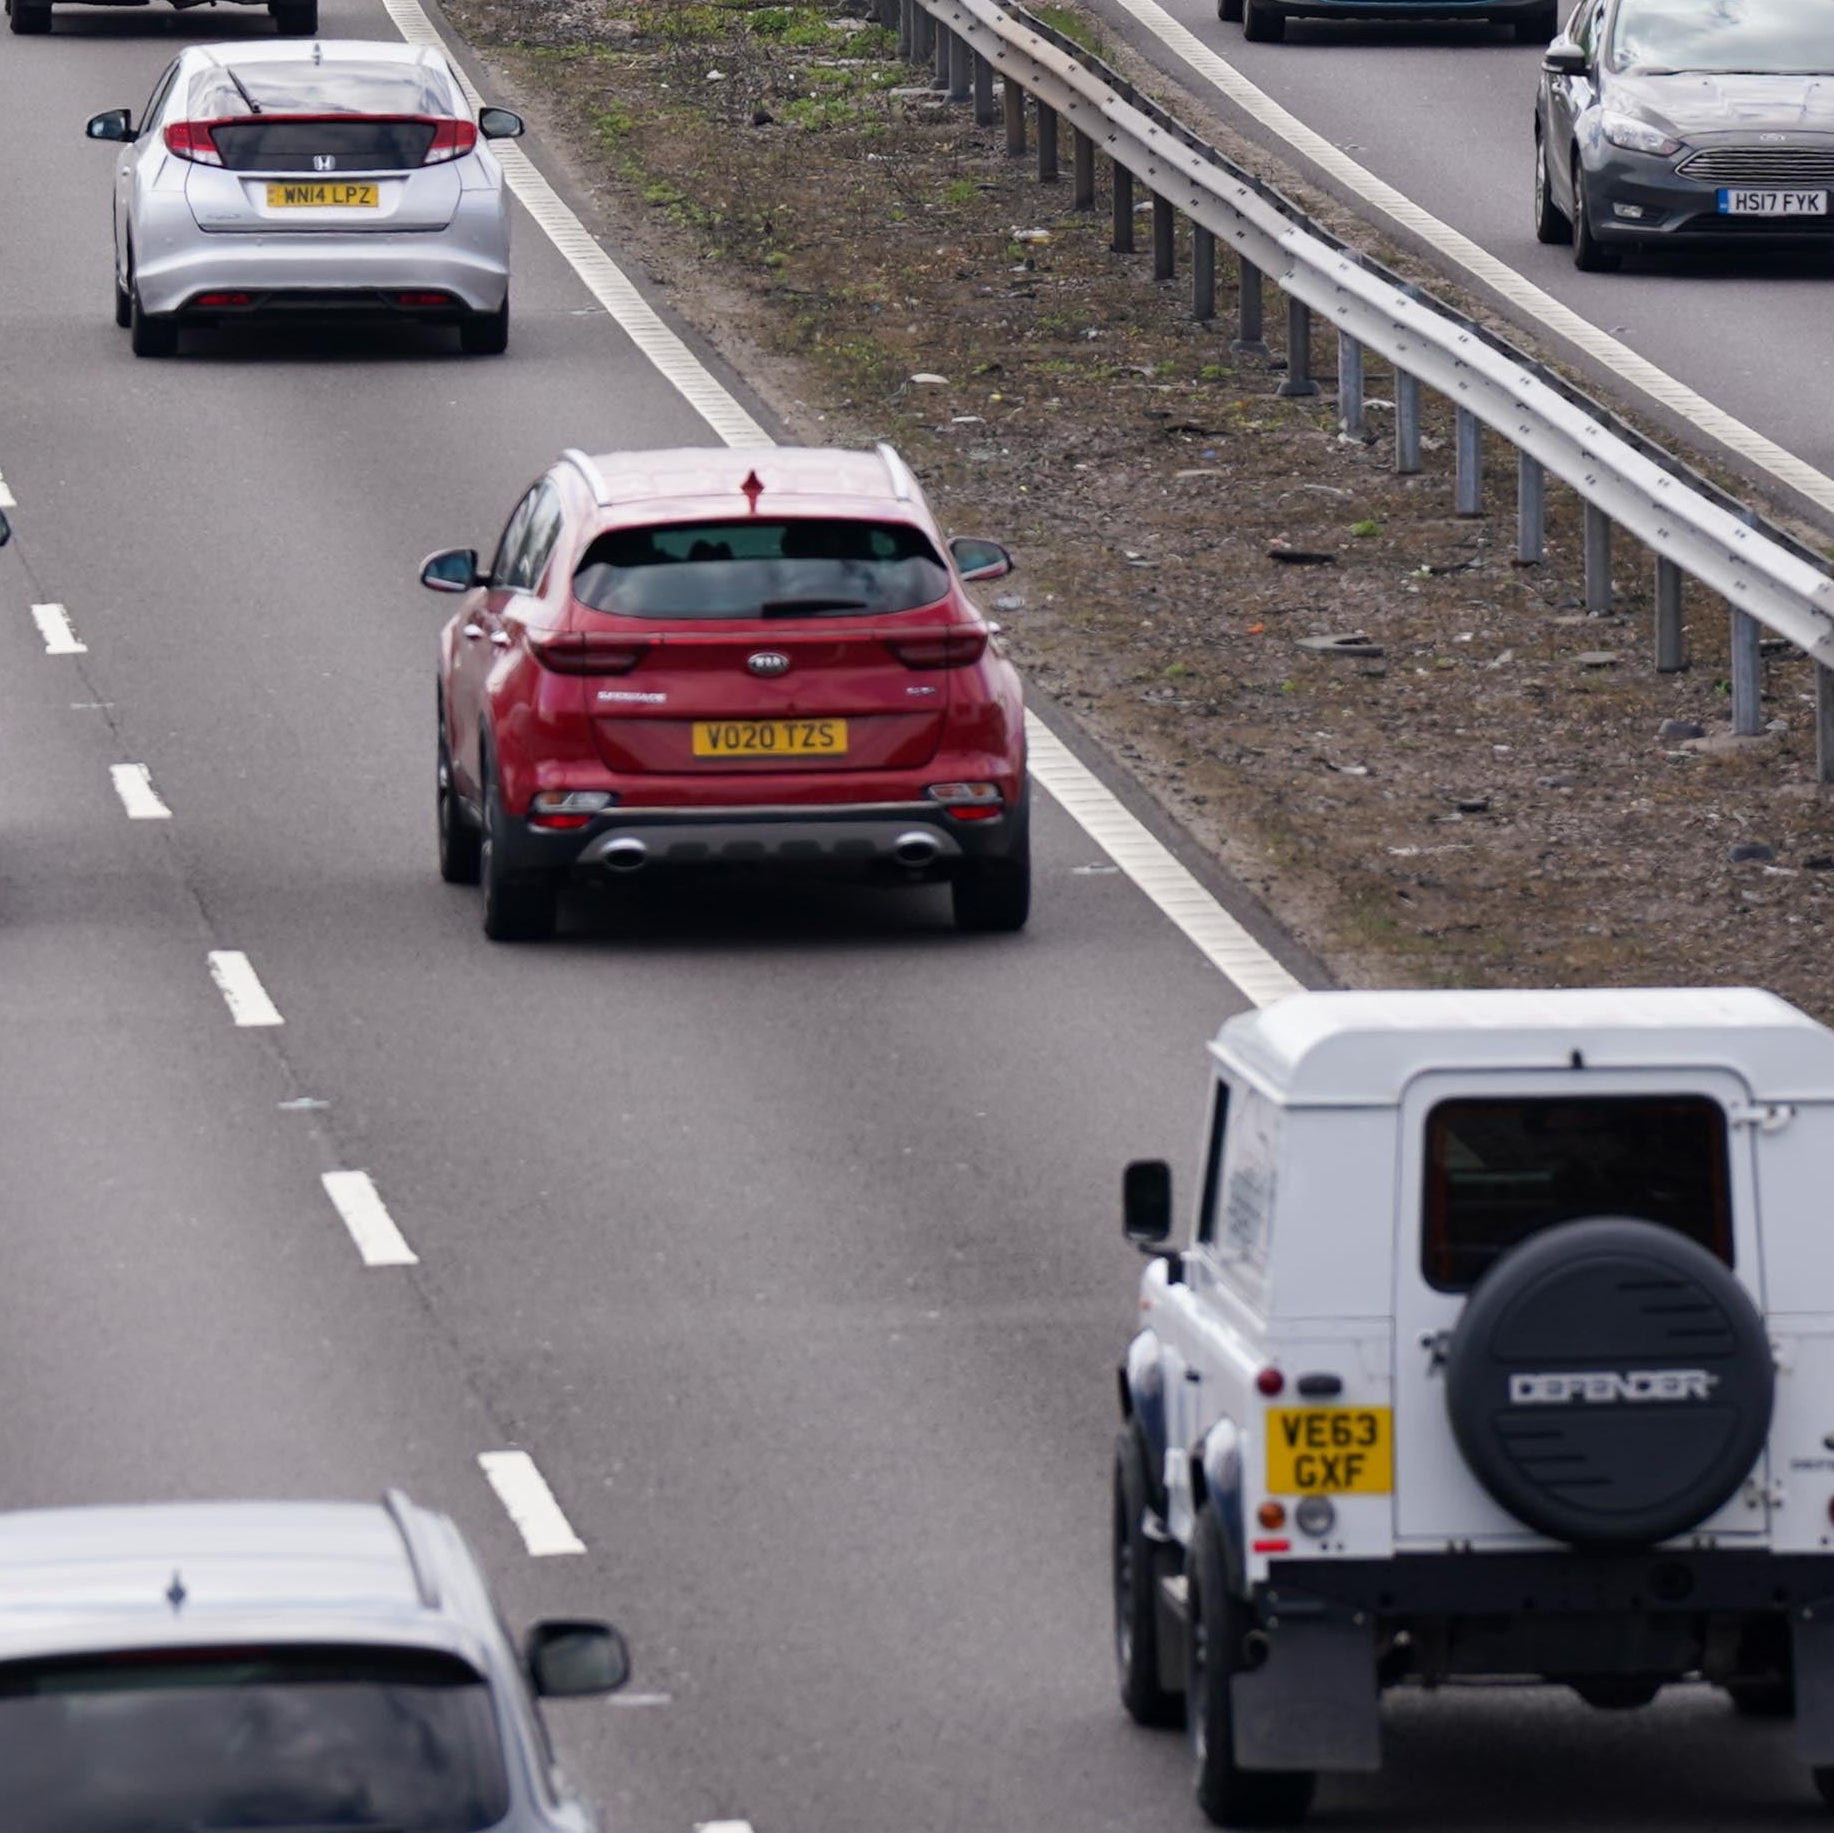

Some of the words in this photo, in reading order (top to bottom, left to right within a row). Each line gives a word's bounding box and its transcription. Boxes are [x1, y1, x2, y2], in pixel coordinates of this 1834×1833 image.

[284, 188, 325, 204] WN14
[333, 187, 370, 204] LPZ
[1736, 193, 1778, 212] HS17
[1783, 193, 1820, 212] FYK
[707, 726, 775, 750] VO20
[785, 724, 834, 747] TZS
[1510, 1371, 1719, 1403] DEFENDER
[1281, 1413, 1378, 1448] VE63
[1293, 1453, 1368, 1488] GXF
